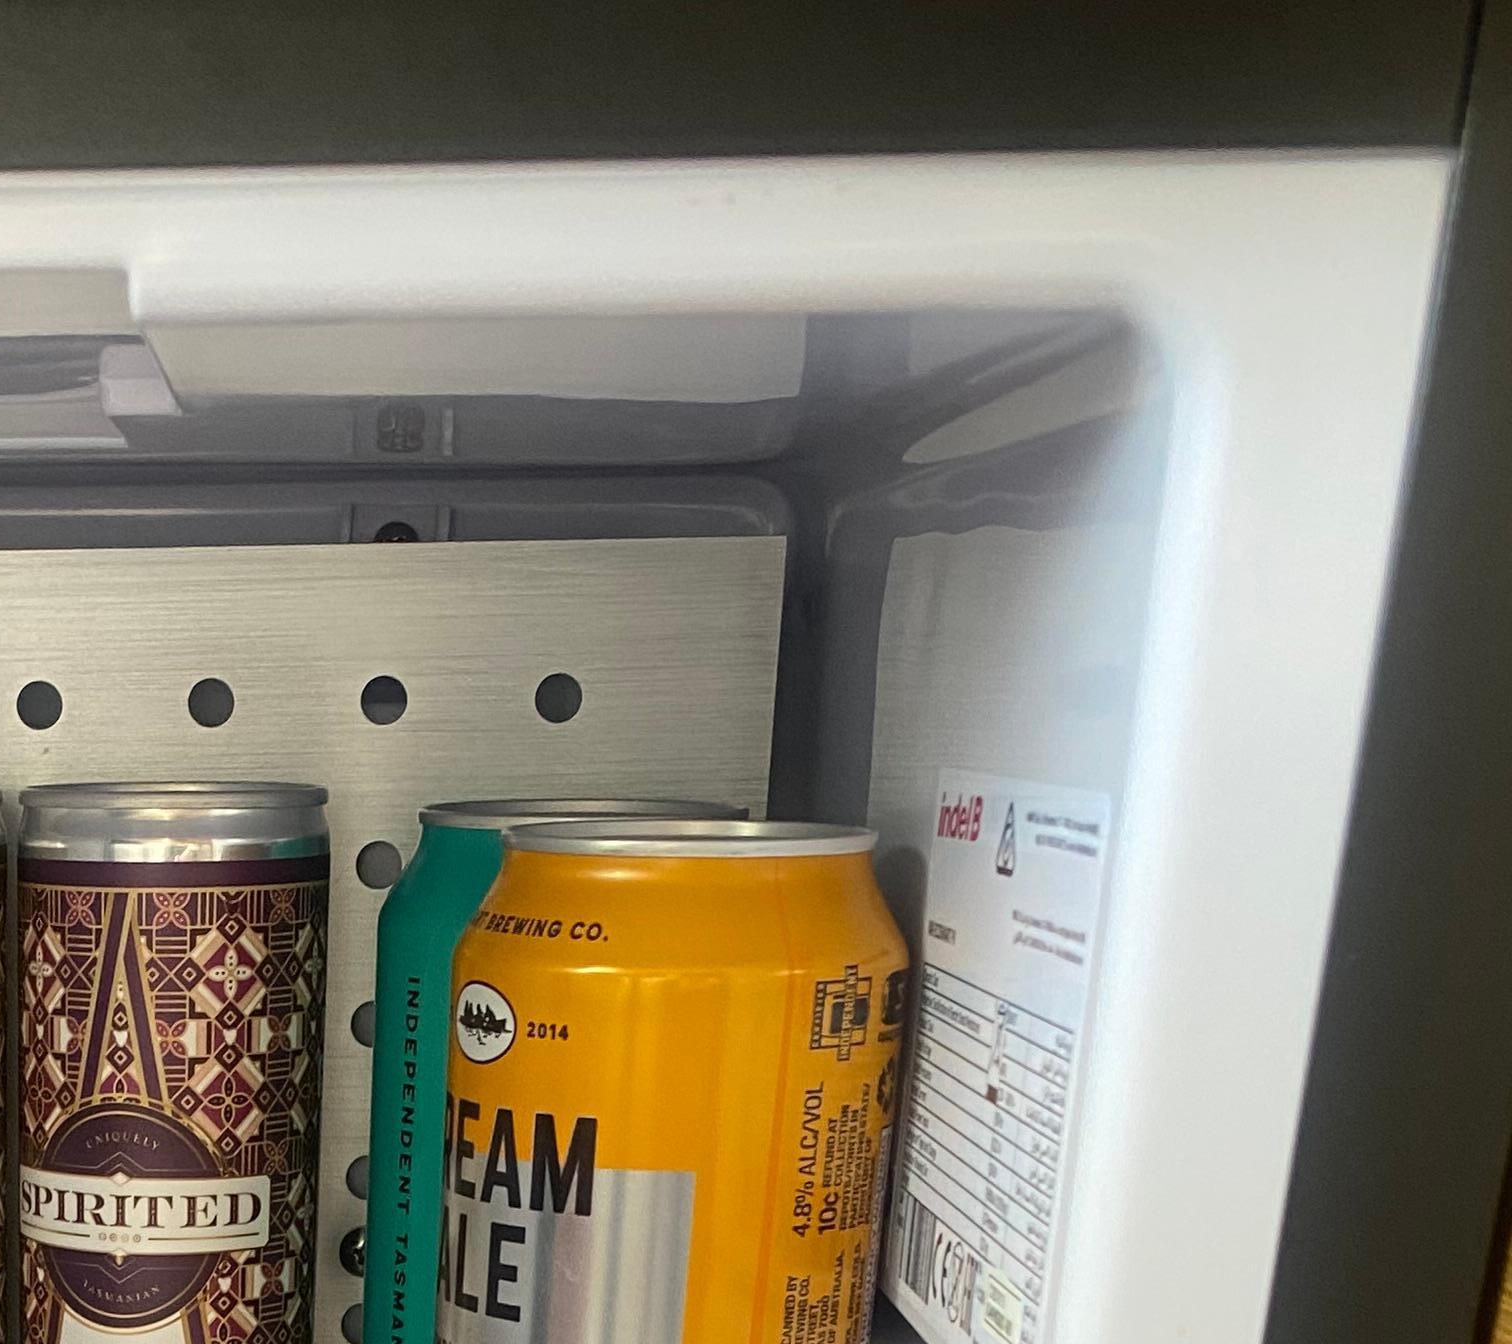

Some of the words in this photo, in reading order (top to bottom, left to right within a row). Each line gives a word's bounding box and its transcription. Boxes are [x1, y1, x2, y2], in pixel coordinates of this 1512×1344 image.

[485, 912, 563, 939] BREWING
[570, 922, 608, 942] CO.
[526, 1021, 569, 1041] 2014
[395, 976, 421, 1215] INDEPENDENT
[799, 1081, 824, 1176] ALC/VOL
[21, 1180, 262, 1229] SPIRITED
[793, 1181, 815, 1238] 4.8%
[786, 1276, 798, 1293] BY
